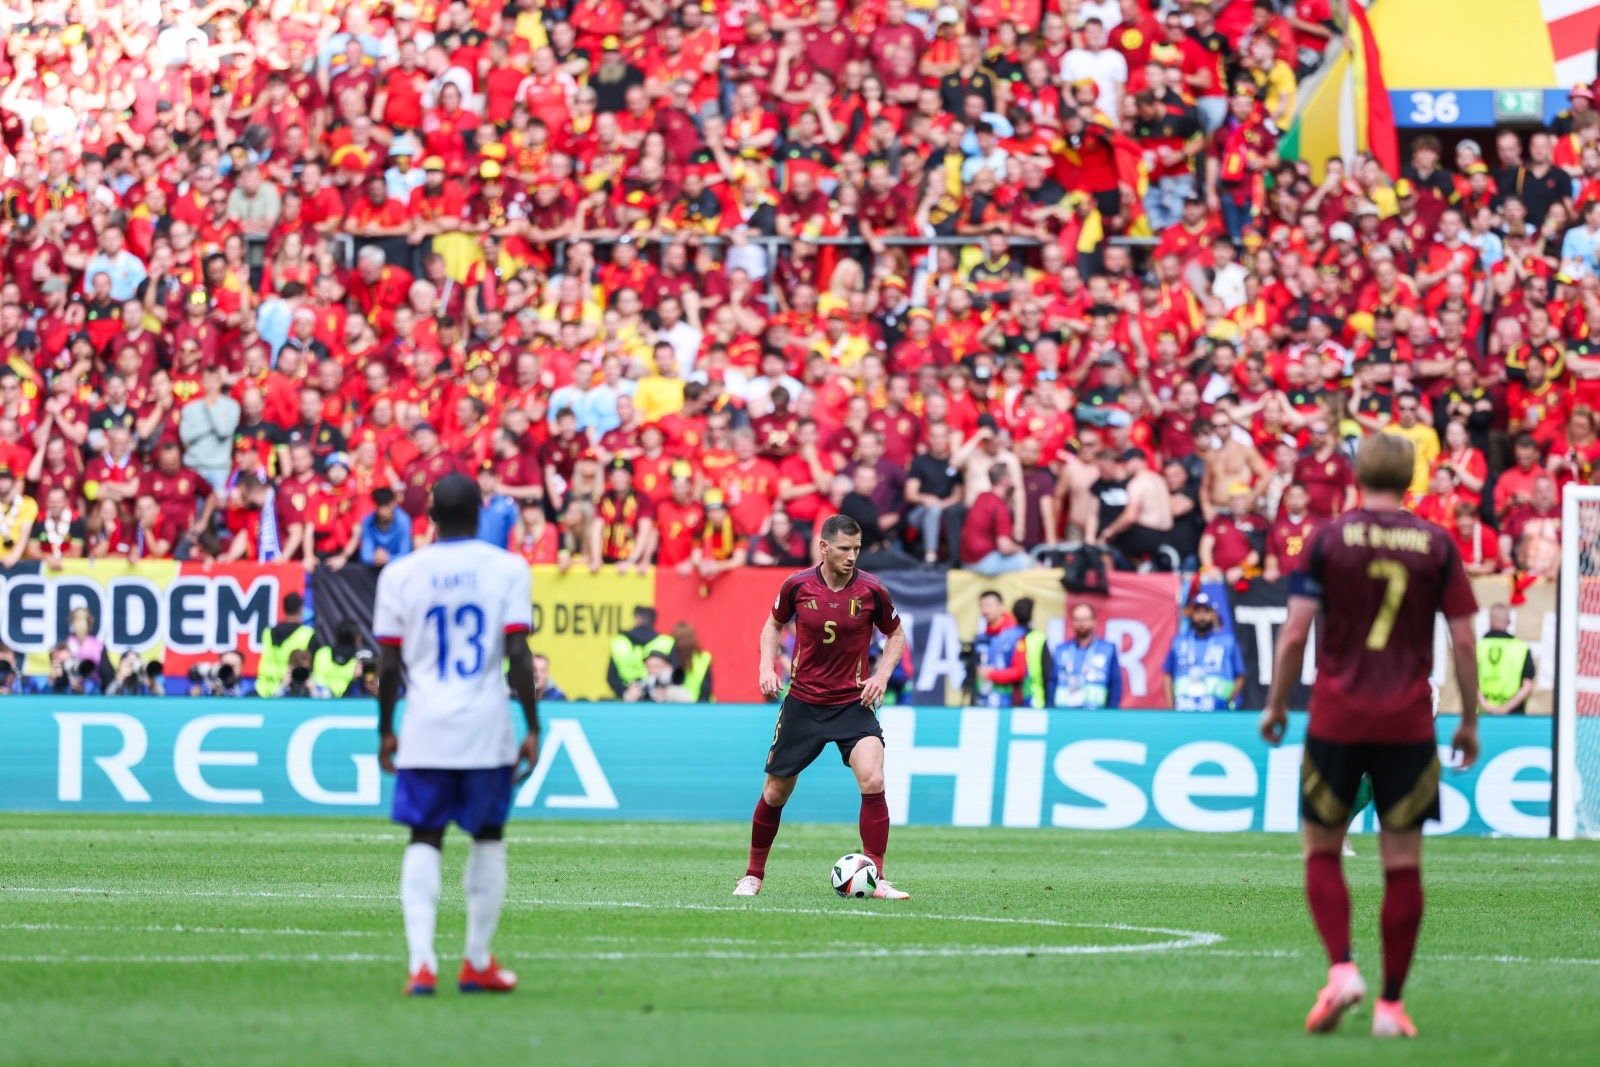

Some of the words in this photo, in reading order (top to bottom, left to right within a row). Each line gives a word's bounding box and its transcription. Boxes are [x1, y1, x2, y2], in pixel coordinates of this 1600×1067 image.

[1409, 92, 1460, 123] 36
[1342, 522, 1366, 548] DE
[424, 603, 486, 681] 13
[822, 620, 838, 645] 5
[1366, 558, 1408, 650] 7
[53, 711, 619, 808] REGA
[876, 706, 1556, 840] Hisese
